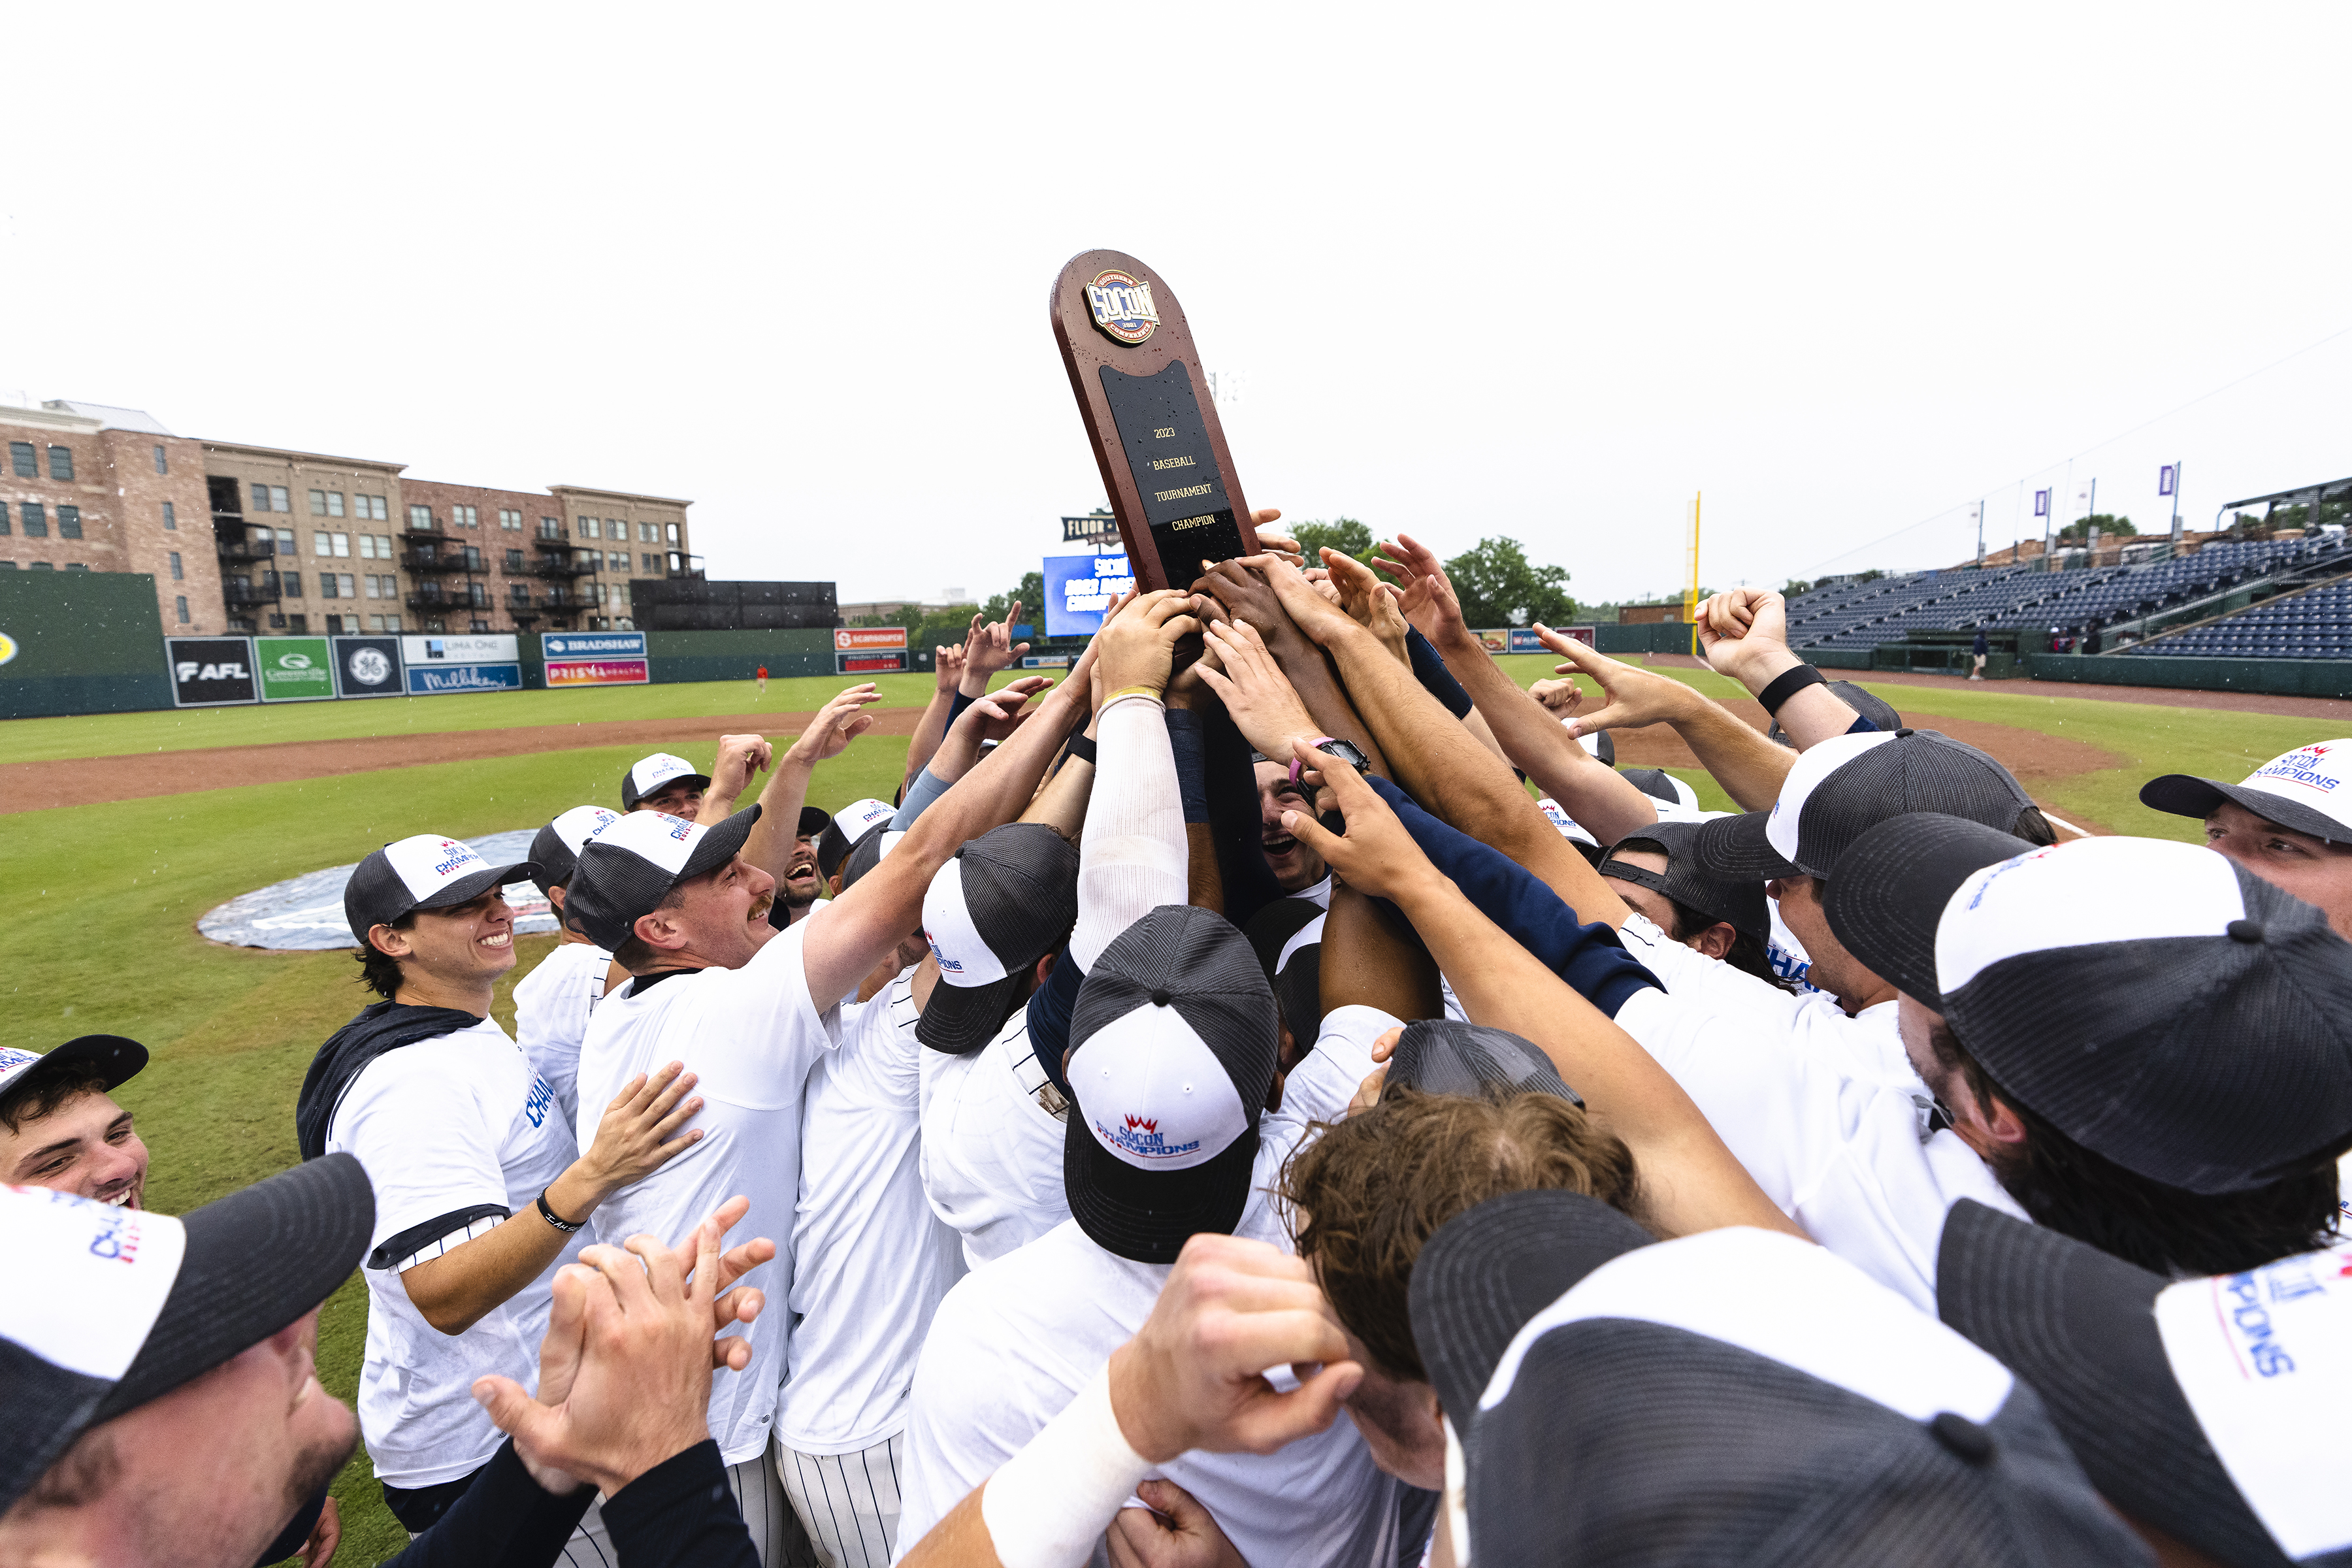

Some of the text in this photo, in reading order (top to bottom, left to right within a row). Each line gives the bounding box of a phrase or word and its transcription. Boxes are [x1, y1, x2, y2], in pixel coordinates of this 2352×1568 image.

[1098, 274, 1134, 286] SOUTHERN
[1088, 283, 1156, 324] SOCON
[1109, 323, 1151, 338] CONFERENCE
[1154, 427, 1175, 438] 2023
[1152, 455, 1196, 470] BASEBALL
[1154, 483, 1212, 502] TOURNAMENT
[1068, 519, 1105, 537] FLUOR
[1171, 514, 1216, 531] CHAMPION
[567, 639, 642, 651] BRADSHAW
[1096, 1120, 1200, 1155] CHAMPIONS
[1119, 1126, 1164, 1147] SOCON
